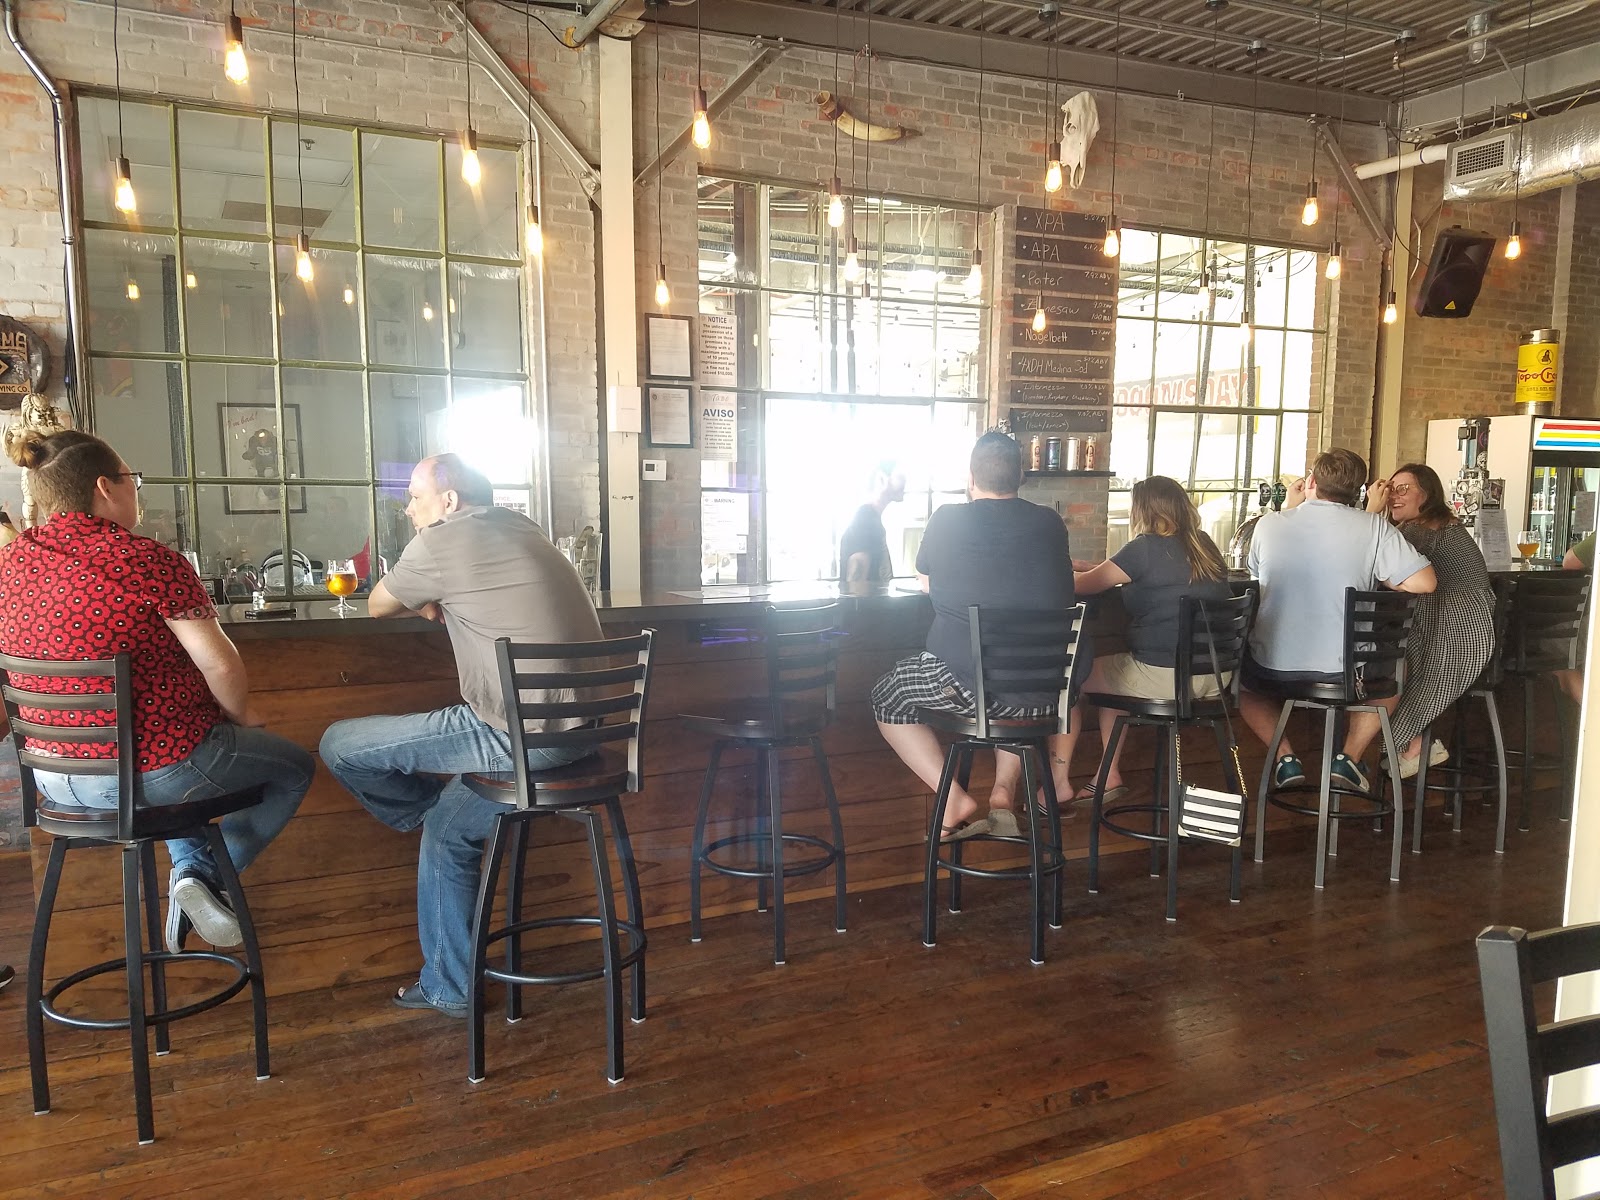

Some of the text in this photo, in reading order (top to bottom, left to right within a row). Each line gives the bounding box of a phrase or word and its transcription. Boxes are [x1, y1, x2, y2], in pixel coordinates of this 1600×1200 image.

[1035, 211, 1065, 232] XPA
[1031, 242, 1060, 261] APA
[707, 316, 728, 324] NOTICE
[703, 408, 734, 418] AVISO
